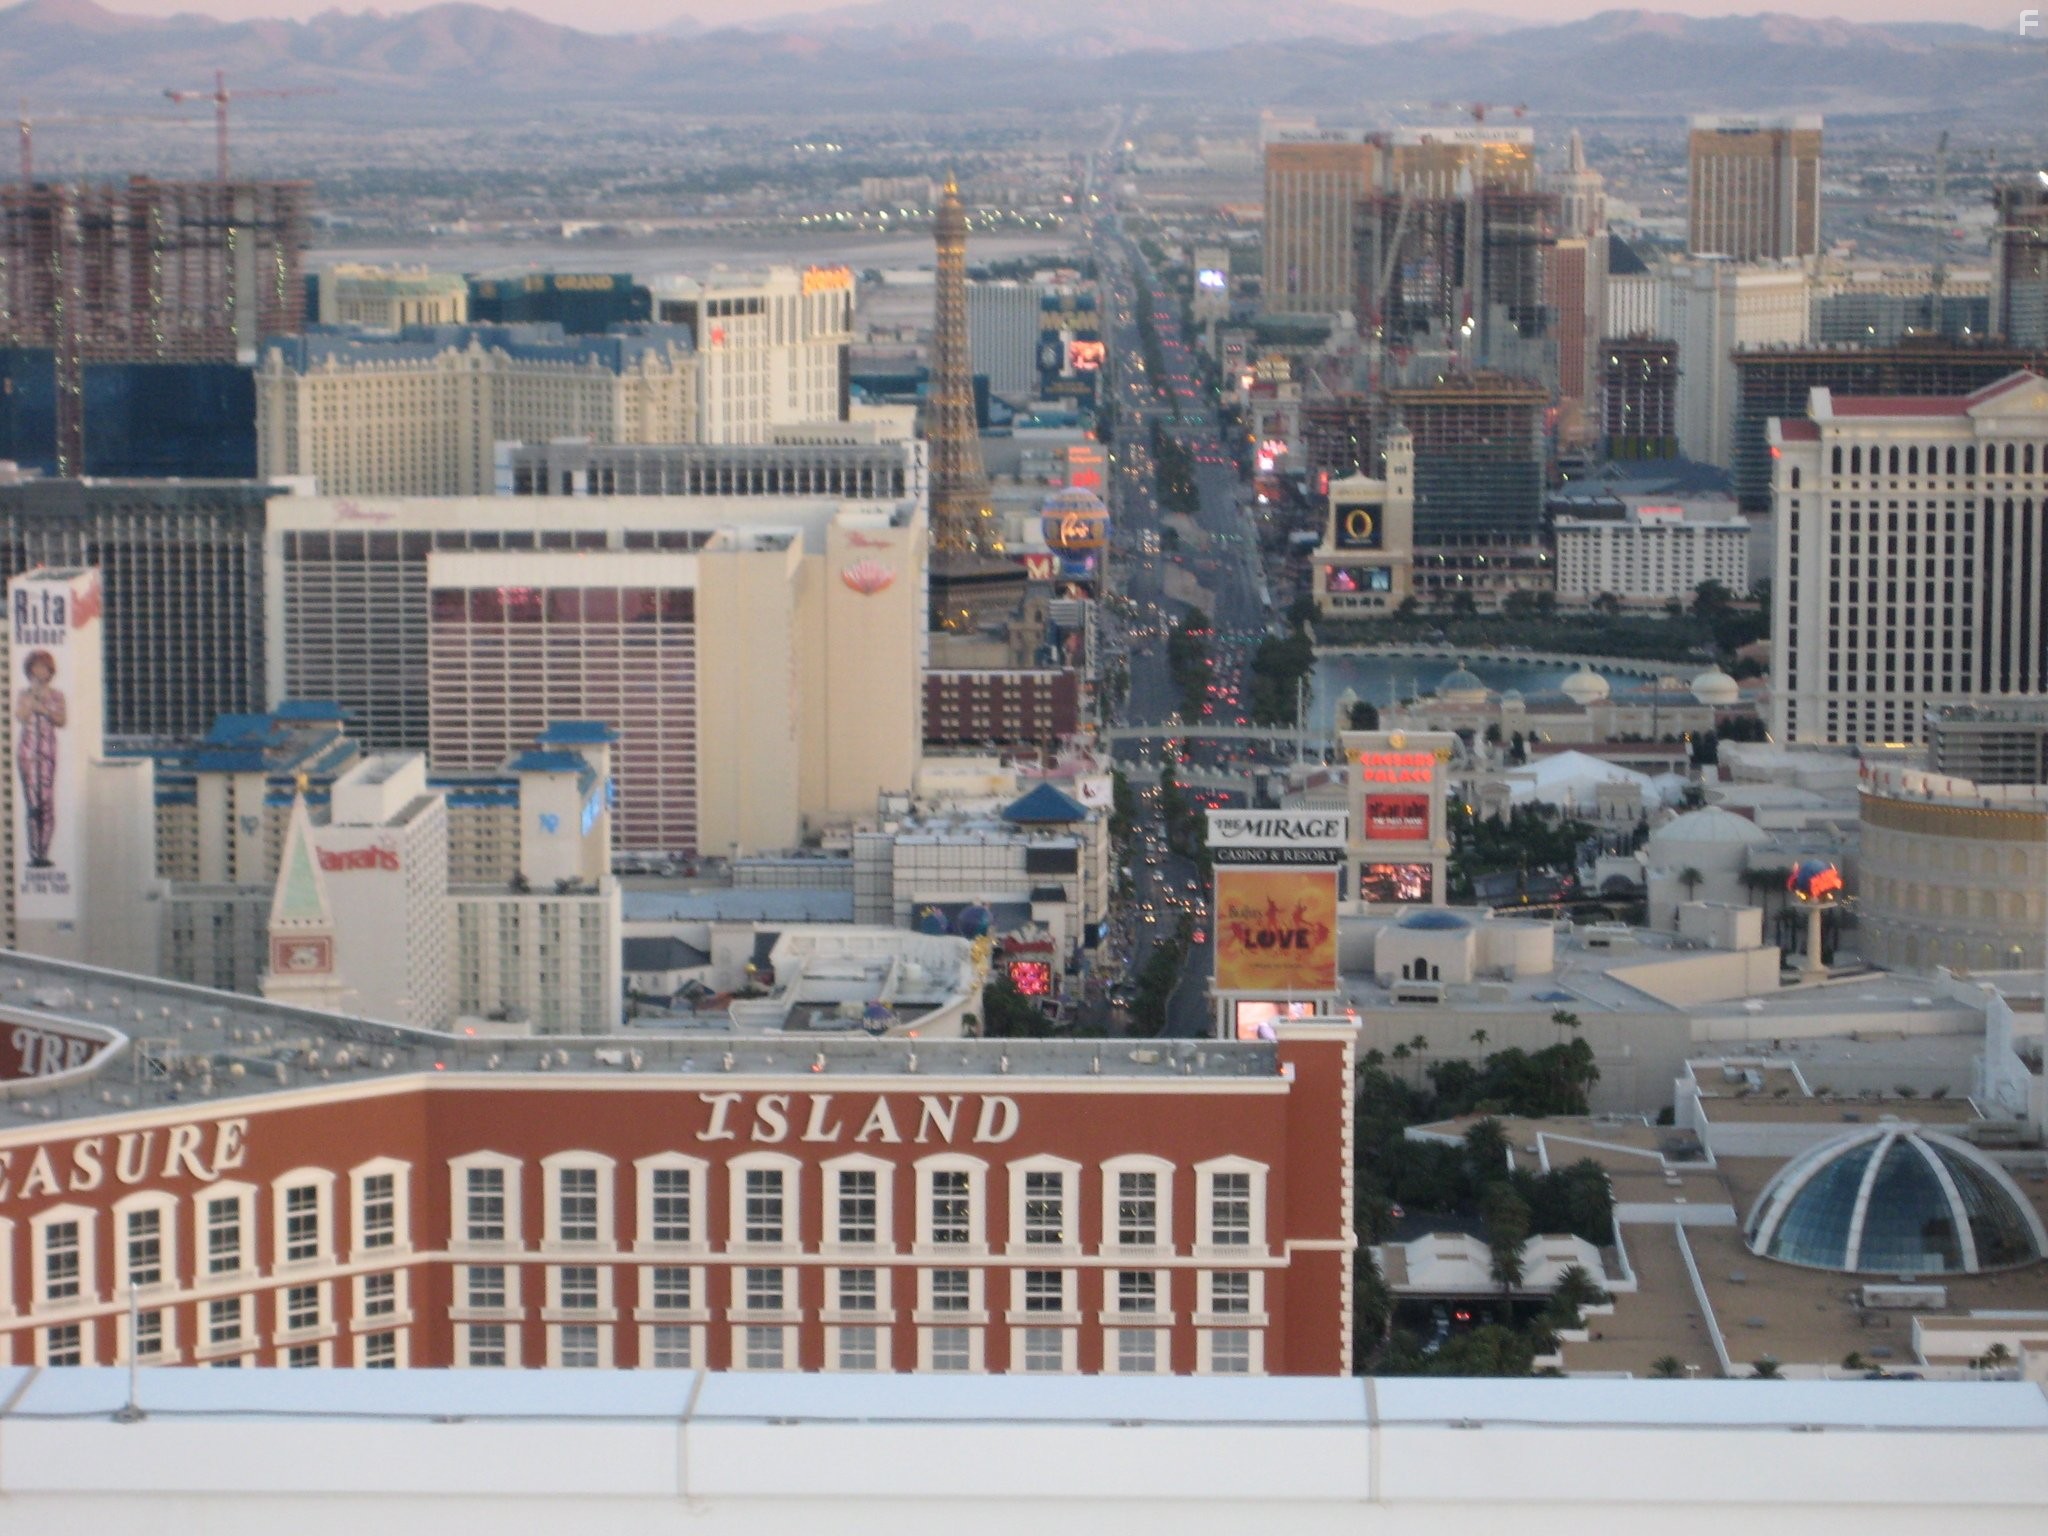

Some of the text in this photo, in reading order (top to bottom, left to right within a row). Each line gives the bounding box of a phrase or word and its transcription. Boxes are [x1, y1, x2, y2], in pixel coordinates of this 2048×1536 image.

[14, 588, 65, 626] Rita
[1360, 751, 1435, 768] CAESARS
[1363, 768, 1432, 783] PALACE
[1213, 818, 1339, 839] THE MIRAGE
[1217, 849, 1338, 862] CASINO & RESORT
[1244, 927, 1309, 949] LOVE
[696, 1092, 1020, 1144] ISLAND
